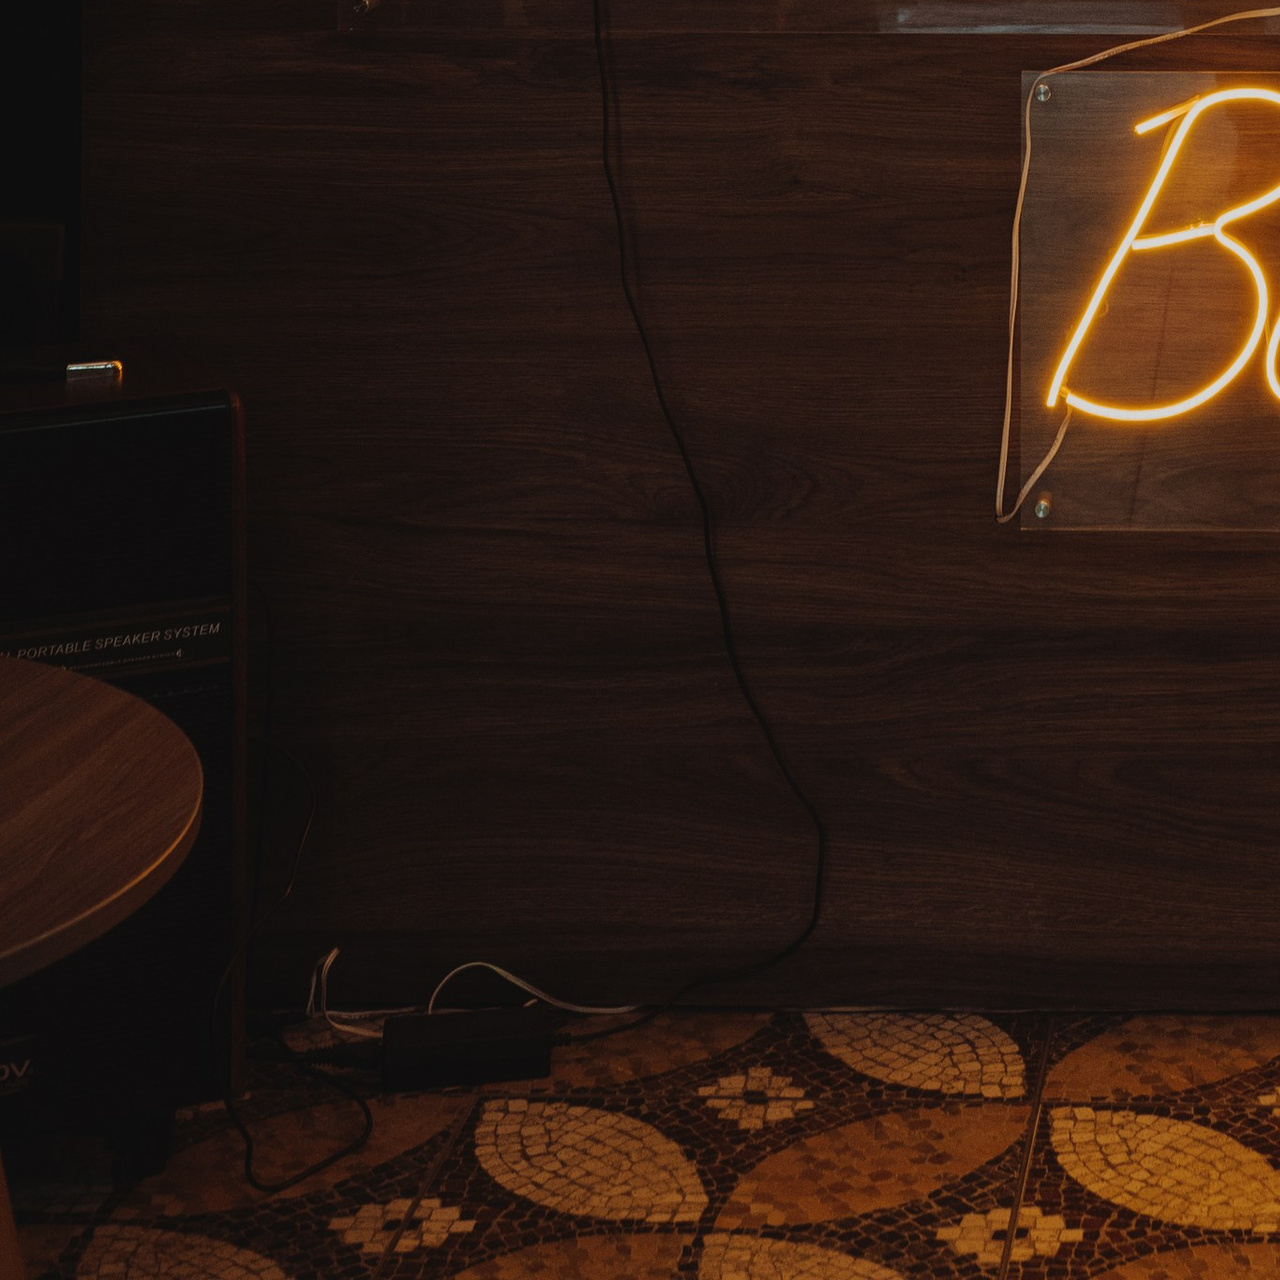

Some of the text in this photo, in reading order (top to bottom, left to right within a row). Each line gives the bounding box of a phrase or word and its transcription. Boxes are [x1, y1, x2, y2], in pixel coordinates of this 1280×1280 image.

[17, 640, 91, 660] PORTABLE
[95, 631, 161, 650] SPEAKER
[164, 622, 221, 641] SYSTEM
